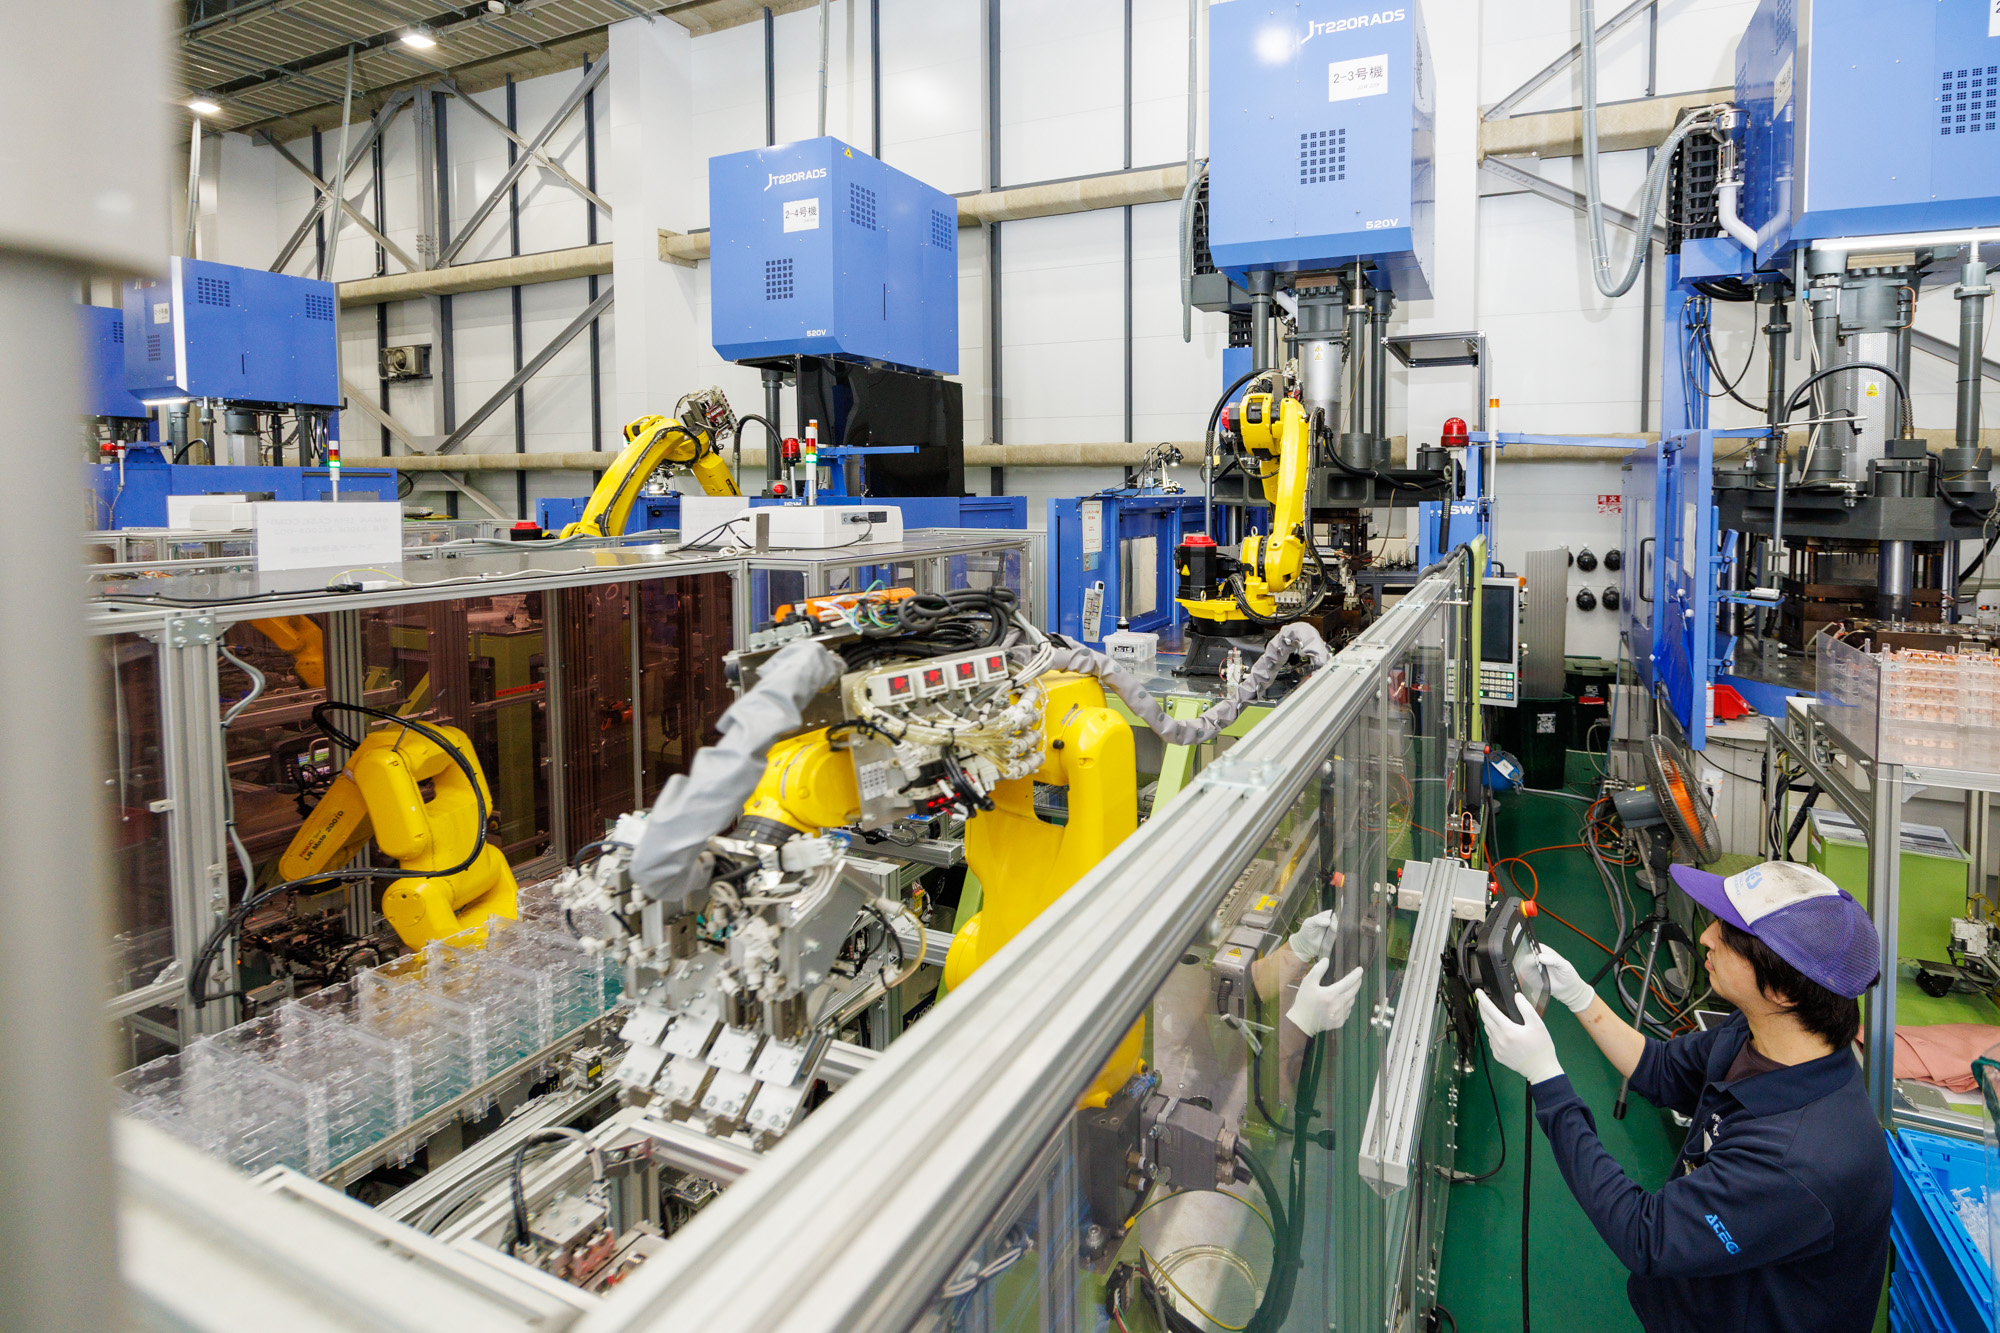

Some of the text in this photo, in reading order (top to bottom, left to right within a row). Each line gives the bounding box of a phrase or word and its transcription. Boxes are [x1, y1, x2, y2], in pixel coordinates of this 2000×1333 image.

[1300, 8, 1405, 45] JT220RADS
[1333, 65, 1383, 84] 2-3号機
[763, 167, 827, 192] JT220RADS
[785, 206, 817, 219] 2-4号機
[1366, 218, 1399, 229] 520V
[806, 329, 827, 337] 520V
[1449, 502, 1475, 515] SW
